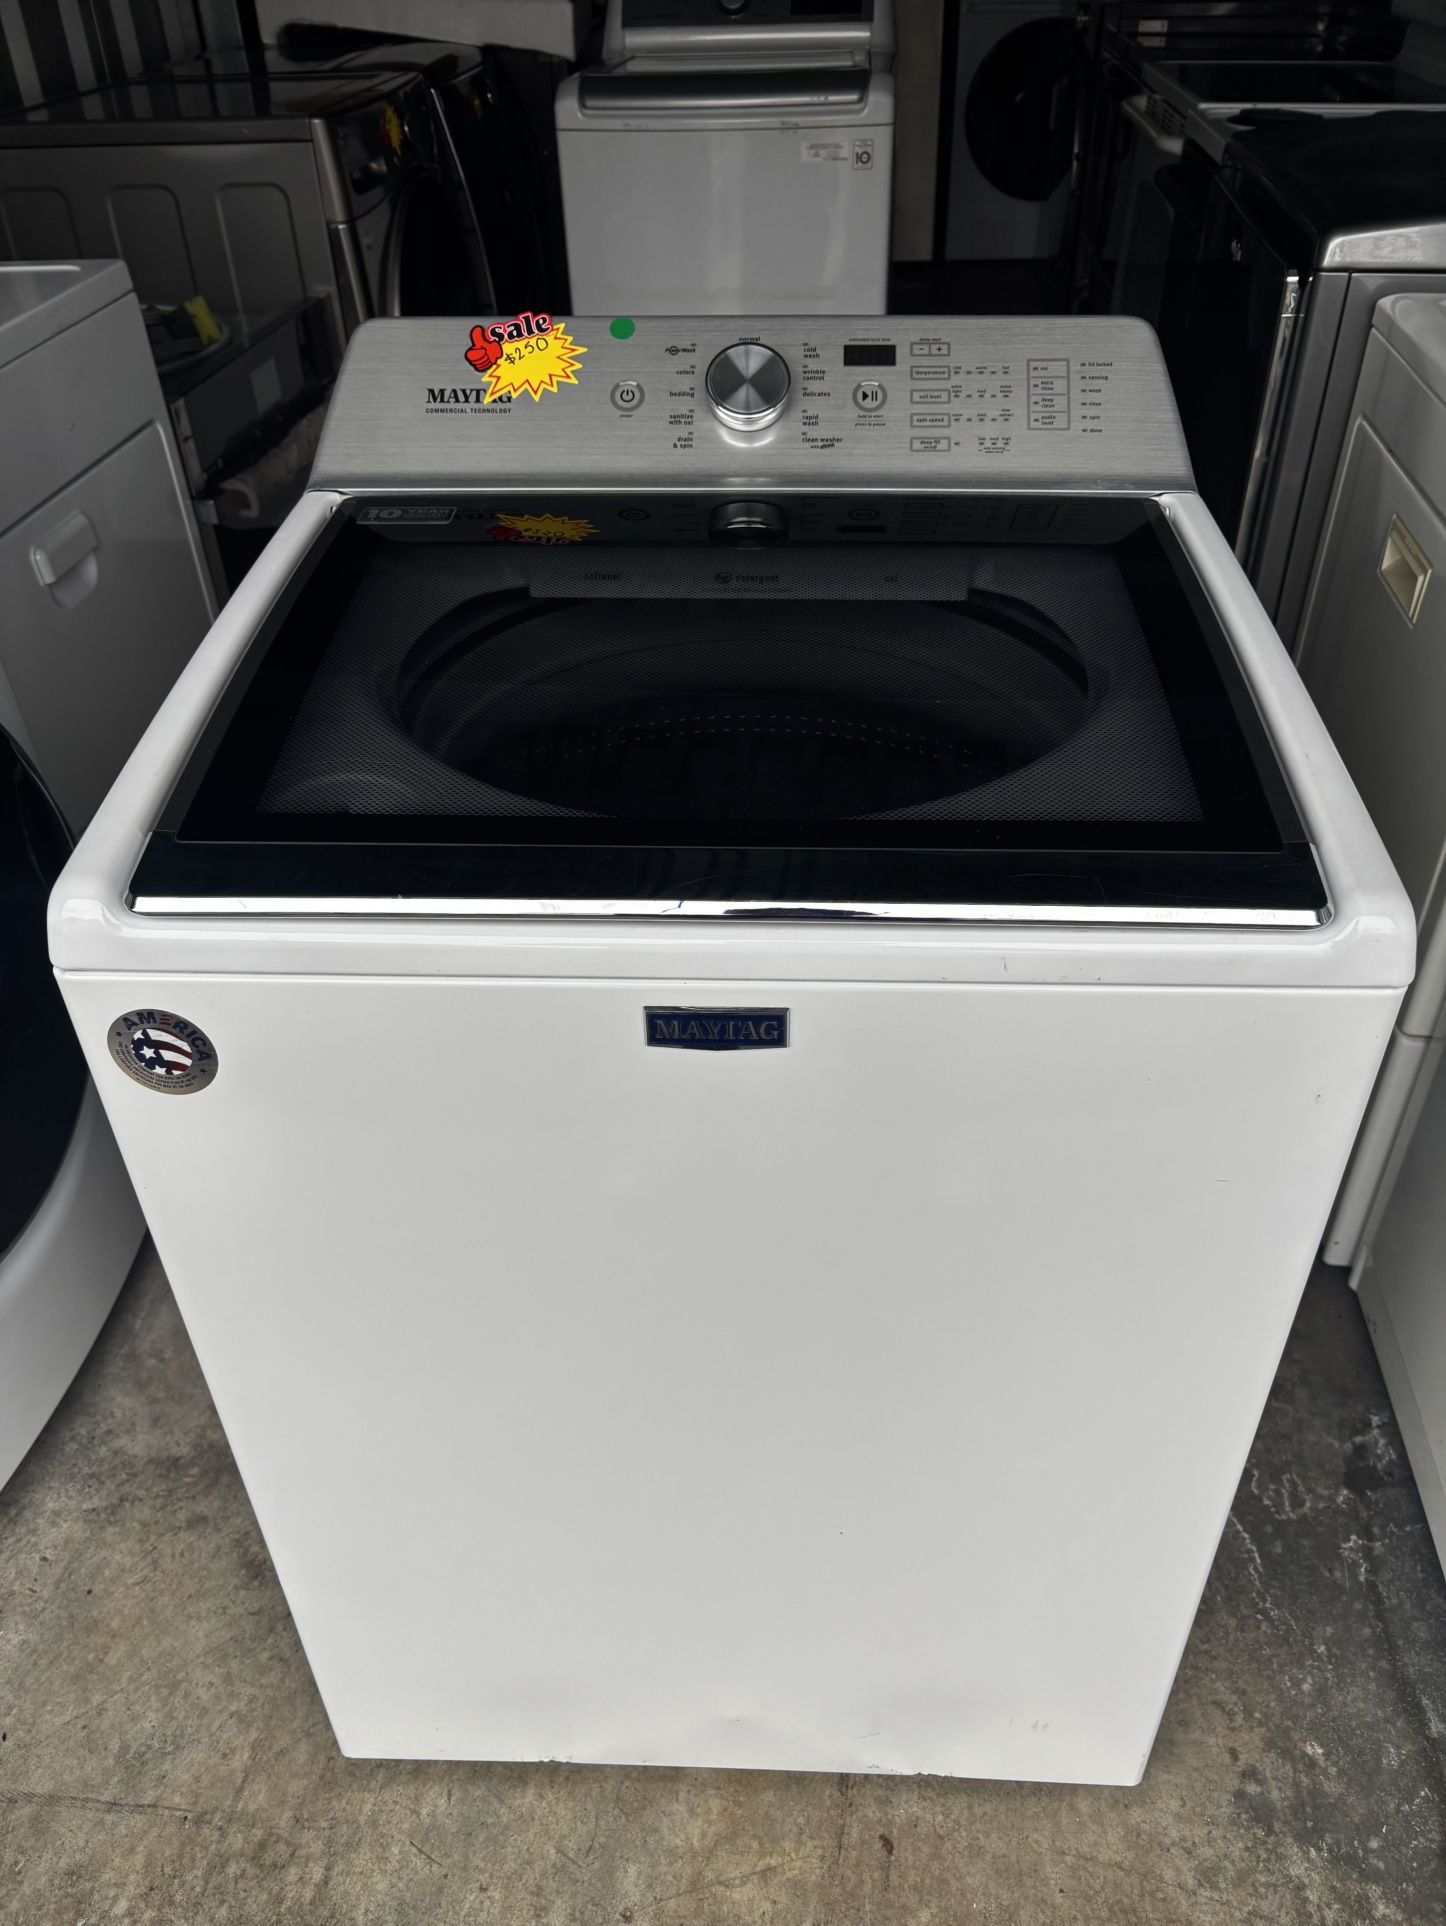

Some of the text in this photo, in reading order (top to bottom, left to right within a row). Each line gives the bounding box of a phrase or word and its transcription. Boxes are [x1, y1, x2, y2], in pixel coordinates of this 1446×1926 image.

[489, 314, 551, 343] sale
[504, 337, 549, 366] $250
[426, 388, 512, 404] MAYTG
[669, 390, 695, 398] bedding
[367, 509, 402, 519] 10
[735, 575, 778, 584] detergent
[122, 1011, 212, 1062] AMERICA
[654, 1019, 779, 1040] MAYTAG
